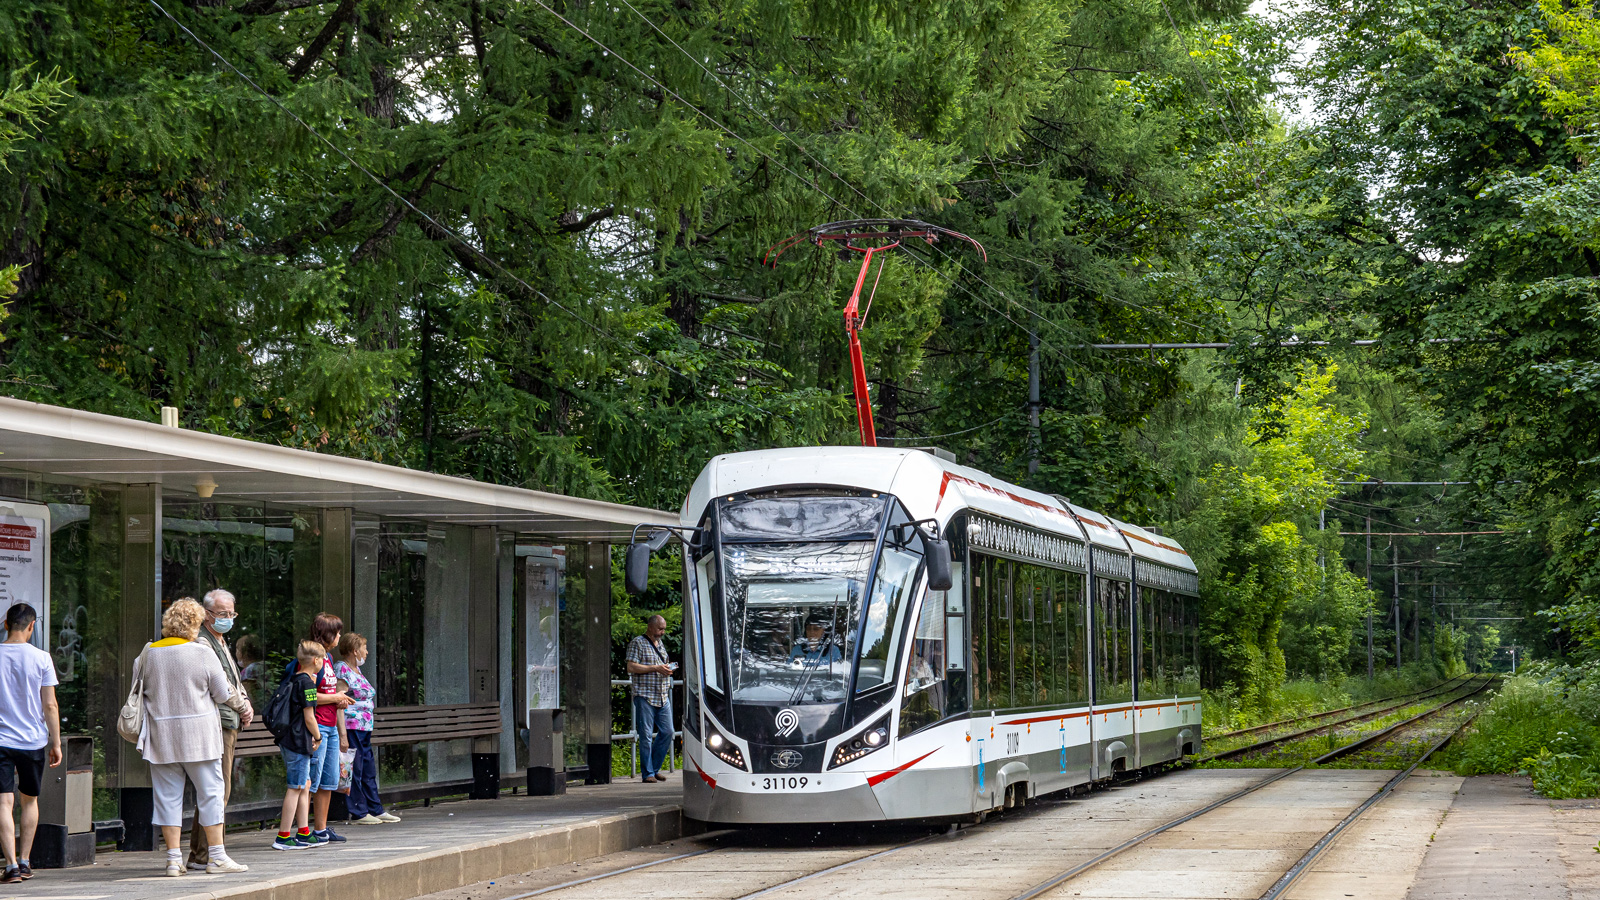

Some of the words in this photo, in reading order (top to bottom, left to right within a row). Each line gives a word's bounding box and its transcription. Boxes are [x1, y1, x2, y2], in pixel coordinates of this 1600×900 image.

[15, 541, 29, 549] Москве
[1006, 731, 1020, 755] 31109
[763, 776, 809, 790] 31109
